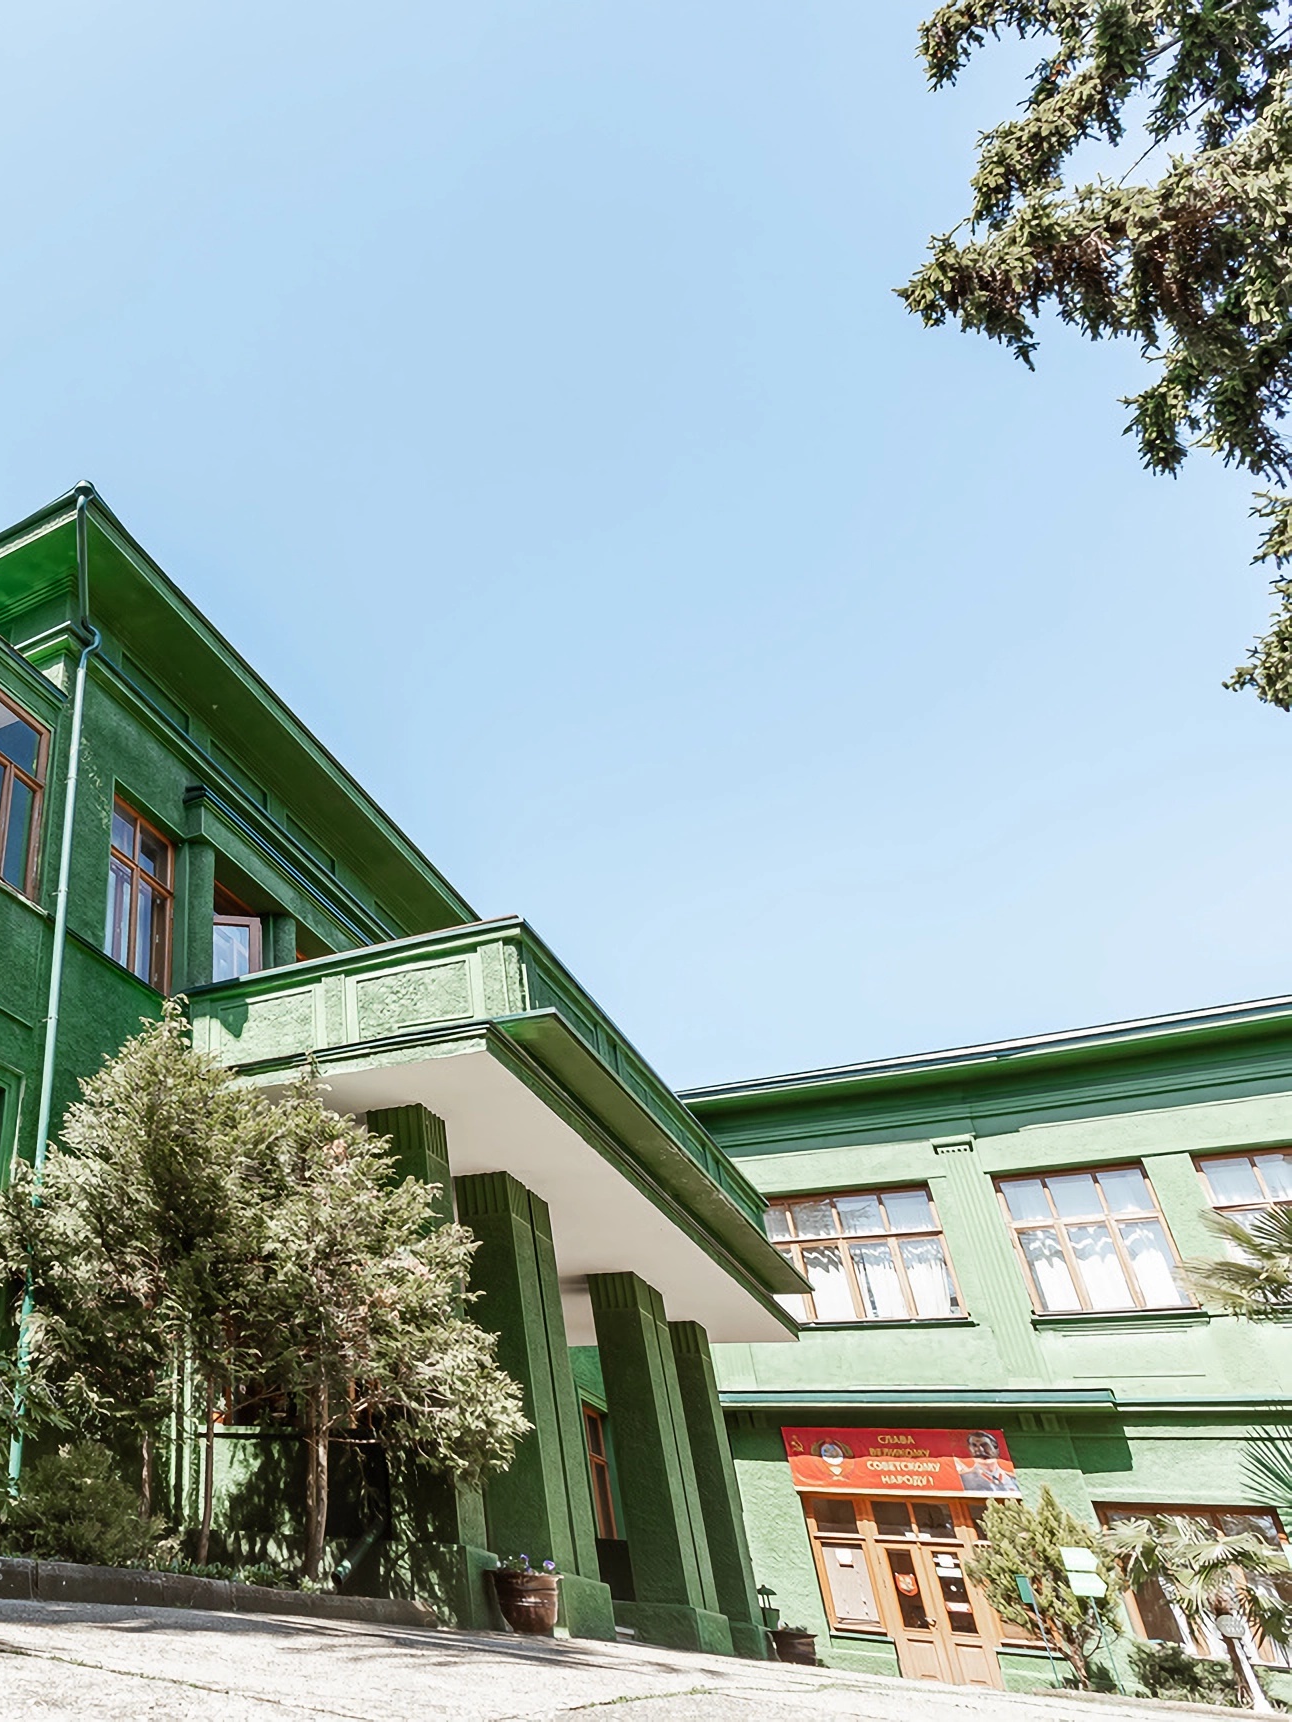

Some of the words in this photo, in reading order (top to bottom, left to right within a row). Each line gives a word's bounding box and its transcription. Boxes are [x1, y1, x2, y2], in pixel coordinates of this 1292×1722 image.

[877, 1435, 915, 1444] СЛАВА
[869, 1447, 930, 1457] ВЕЛИКОМУ
[866, 1461, 940, 1472] СОВЕТСКОМУ
